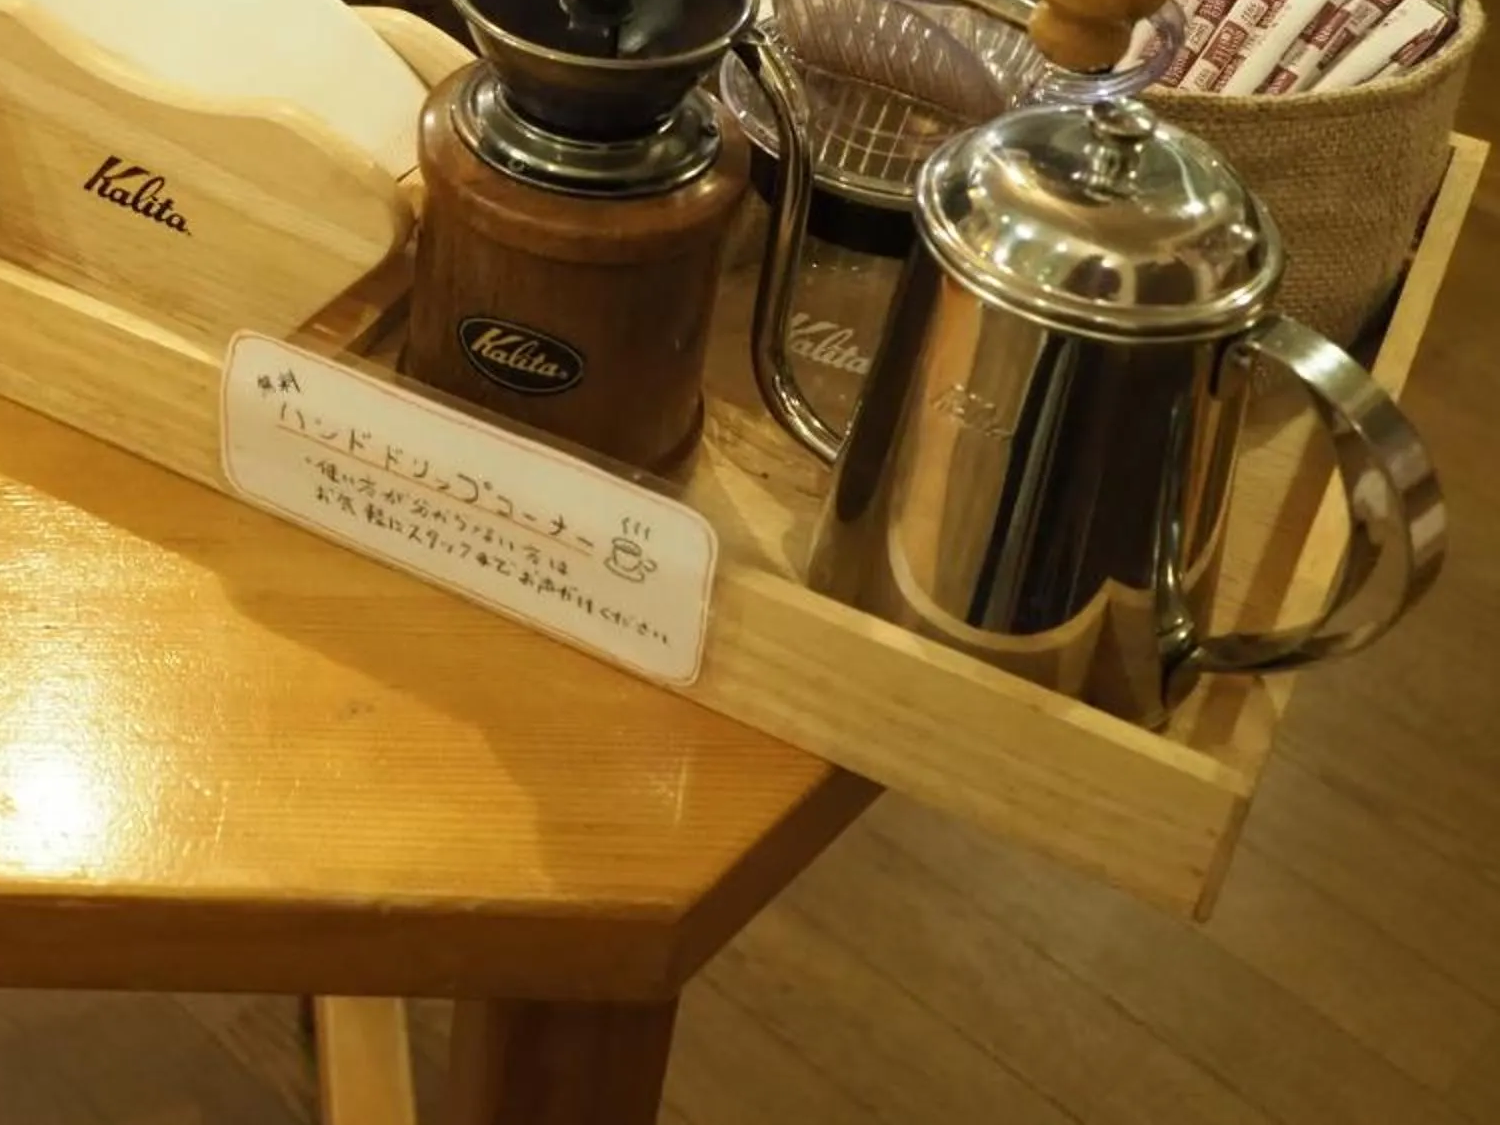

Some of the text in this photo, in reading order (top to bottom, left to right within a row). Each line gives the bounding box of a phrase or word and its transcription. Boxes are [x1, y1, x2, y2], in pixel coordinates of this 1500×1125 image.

[83, 154, 188, 233] Kalita
[470, 327, 559, 377] Kalita
[279, 401, 595, 548] ハンドドリップコーナー
